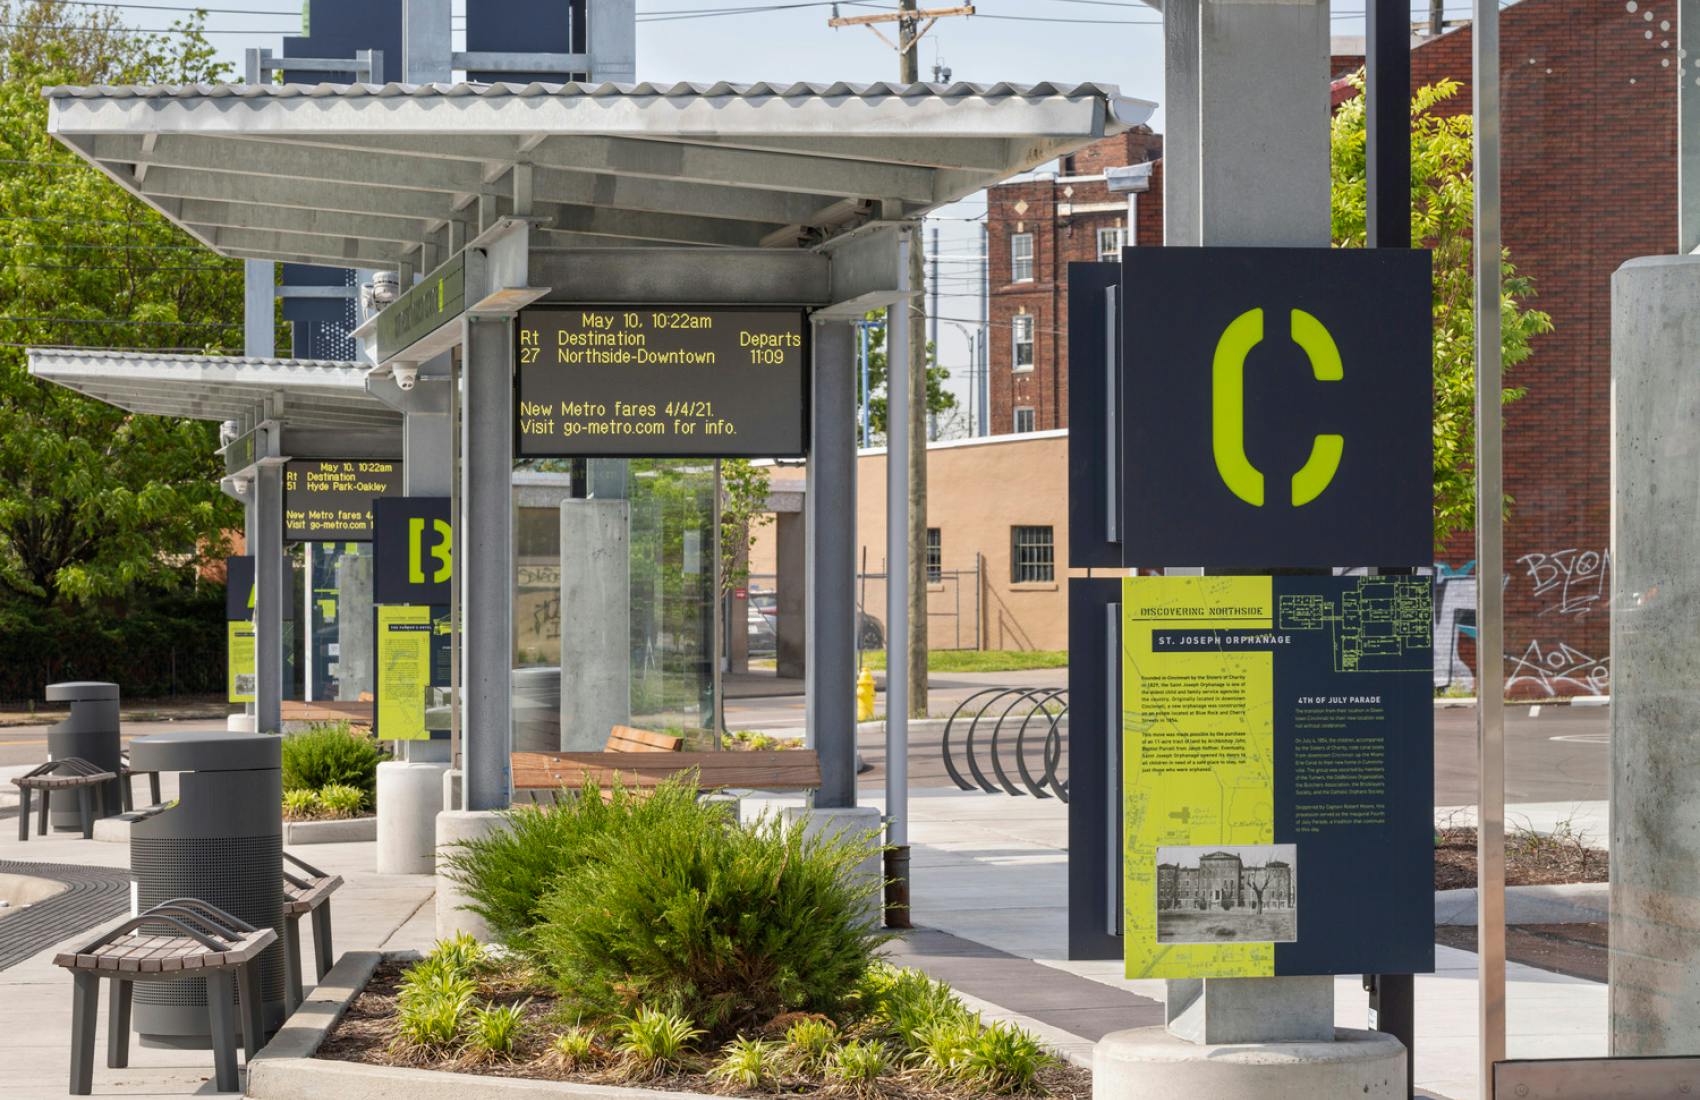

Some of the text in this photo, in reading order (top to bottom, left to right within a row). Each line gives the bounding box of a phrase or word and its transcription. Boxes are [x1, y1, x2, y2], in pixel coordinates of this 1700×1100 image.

[582, 313, 712, 330] May 10, 10:22am
[520, 330, 801, 348] Rt Destination Departs
[520, 348, 784, 364] 27 Northside-Downtown 11:09
[520, 401, 714, 417] New Metro fares 4/4/21.
[1213, 308, 1343, 507] C
[520, 419, 737, 436] Visit go-metro.com for info.
[320, 463, 339, 473] May
[359, 463, 392, 473] 10:22am
[286, 472, 356, 481] Rt Destination
[286, 482, 387, 492] 51 Hyde Park-Oakley
[286, 510, 305, 519] New
[308, 510, 334, 520] Metro
[338, 510, 362, 520] fares
[286, 520, 306, 529] Visit
[310, 520, 366, 530] go-metro.com
[409, 517, 452, 584] B
[1140, 606, 1264, 616] DISCOVERING NORTHSIDE
[1158, 635, 1292, 645] ST. JOSEPH ORPHANAGE
